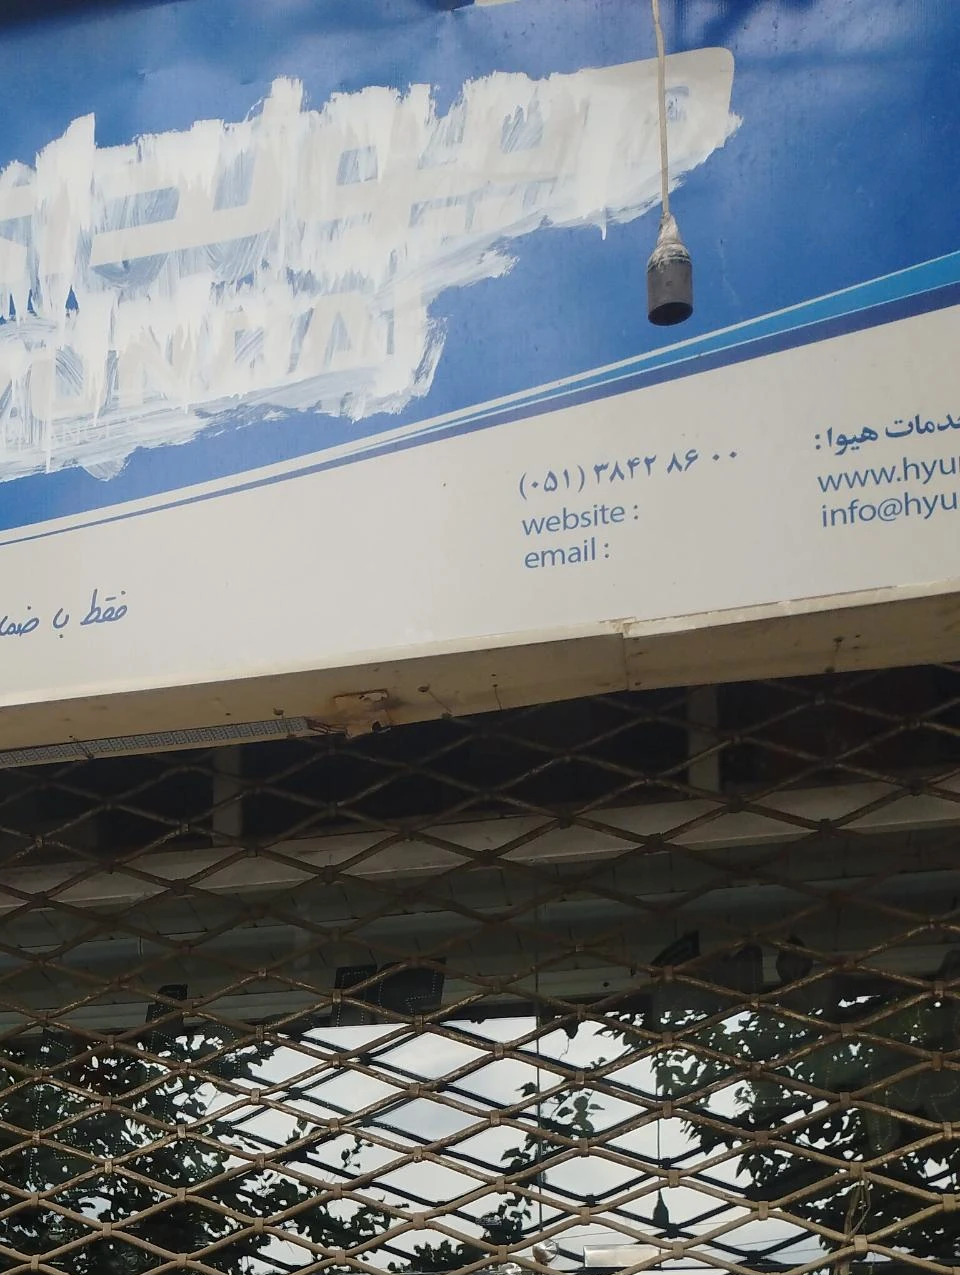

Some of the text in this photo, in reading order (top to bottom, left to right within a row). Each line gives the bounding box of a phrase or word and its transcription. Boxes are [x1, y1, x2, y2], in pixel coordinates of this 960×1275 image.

[885, 413, 960, 438] دمات
[817, 456, 960, 493] www.hyu
[822, 491, 960, 527] info@hyu
[52, 607, 70, 639] با
[80, 588, 128, 626] فقط
